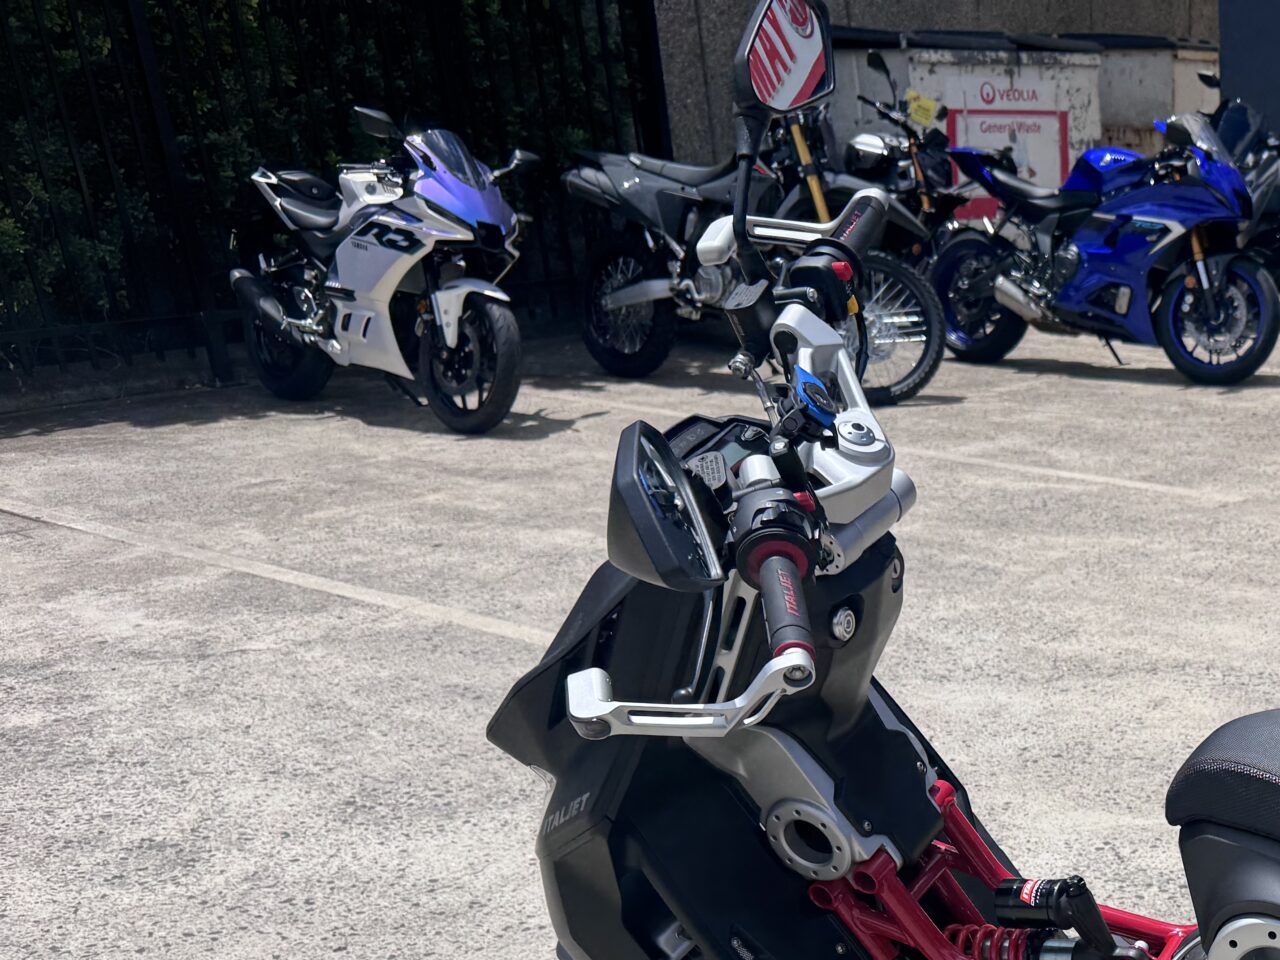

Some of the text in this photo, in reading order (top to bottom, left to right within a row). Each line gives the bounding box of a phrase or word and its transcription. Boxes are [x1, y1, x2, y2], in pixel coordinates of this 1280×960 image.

[997, 88, 1038, 101] VEOLIA
[980, 121, 1014, 134] General
[776, 568, 801, 617] ITALJET
[543, 791, 591, 836] ITALJET
